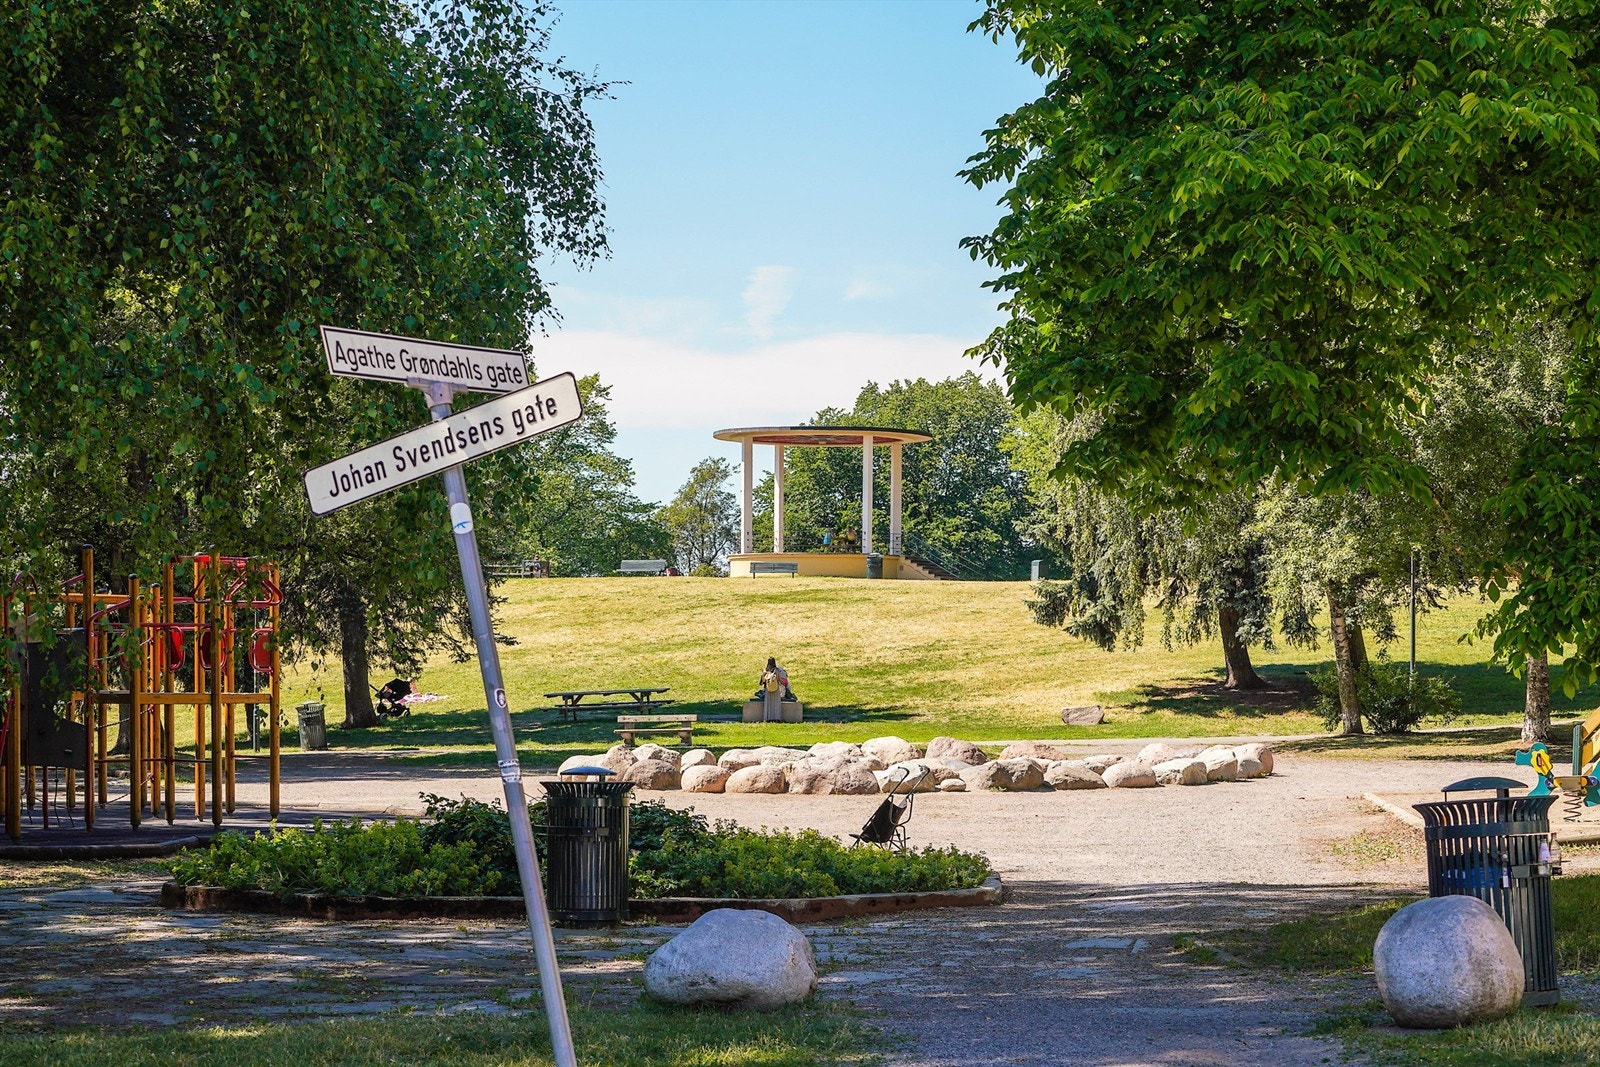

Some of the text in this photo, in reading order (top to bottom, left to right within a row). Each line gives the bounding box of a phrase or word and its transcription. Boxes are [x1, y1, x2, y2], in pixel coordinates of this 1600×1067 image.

[335, 340, 523, 388] Agathe Grøndahls gate
[329, 394, 558, 498] Johan Svendsens gate
